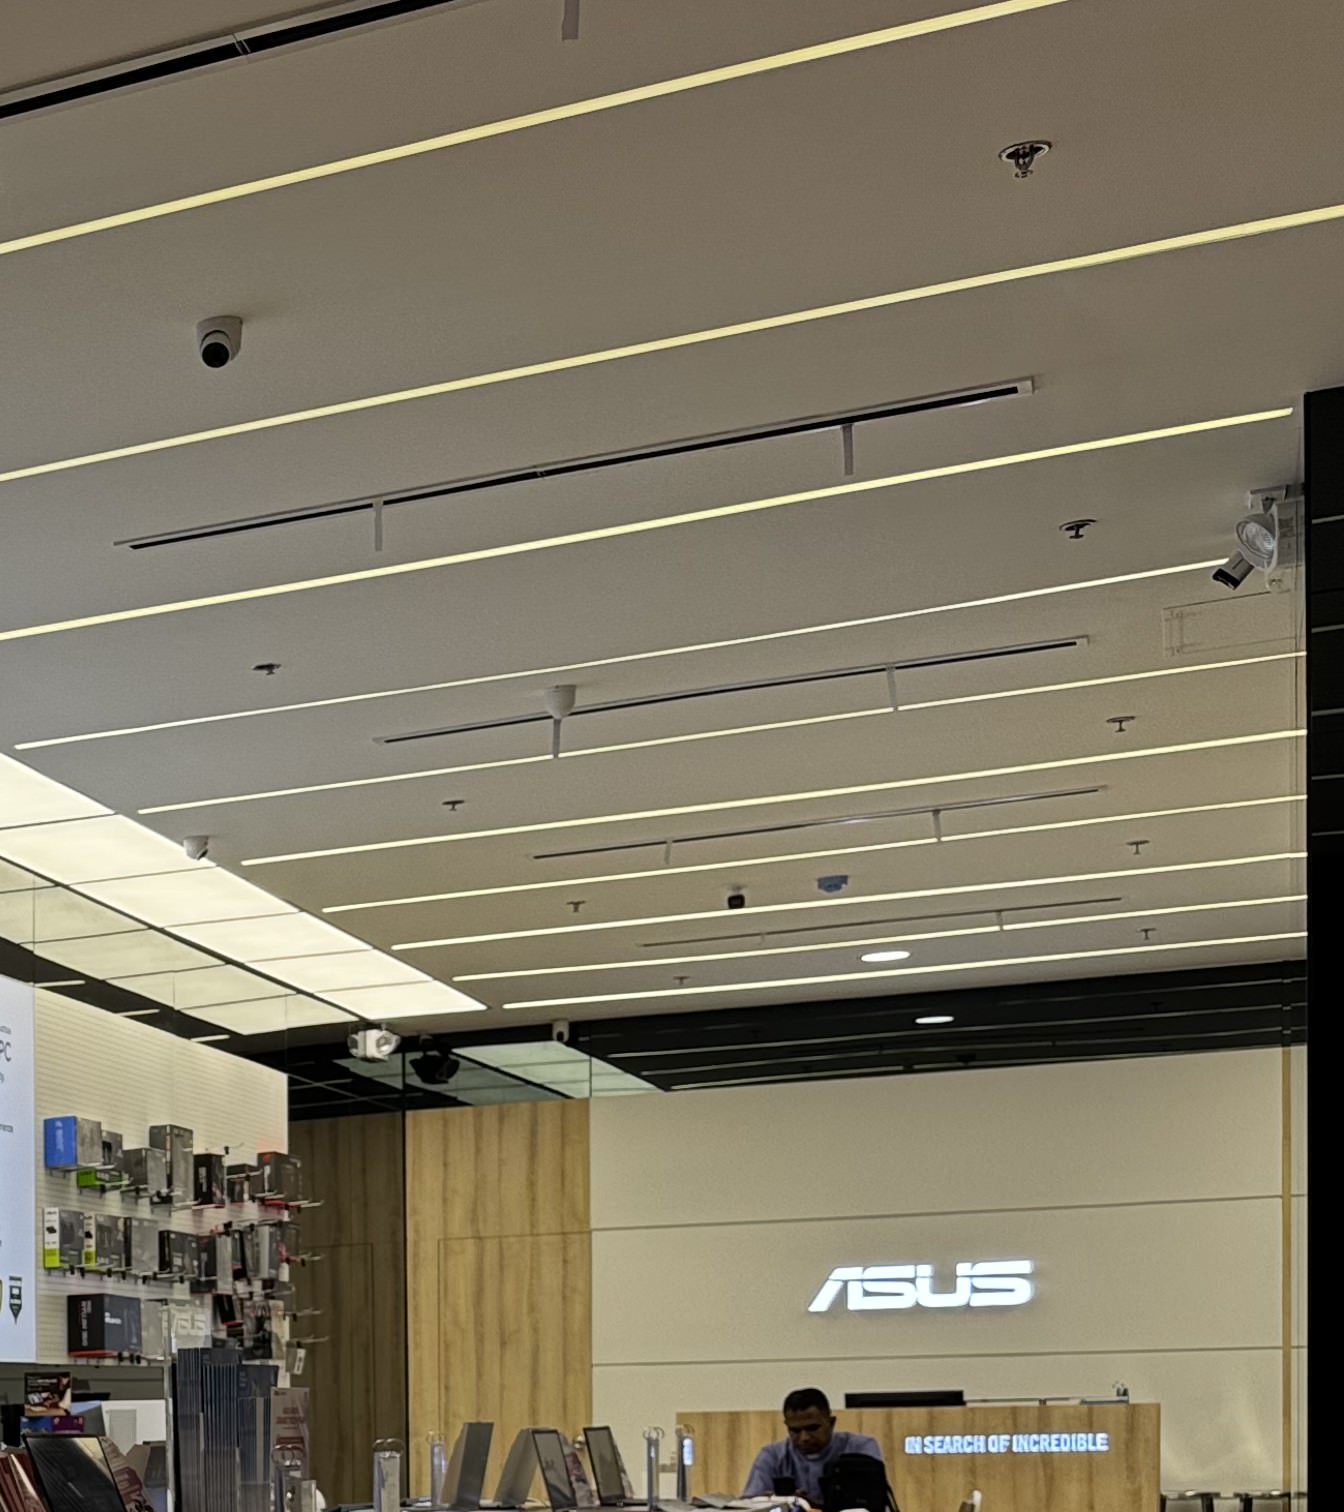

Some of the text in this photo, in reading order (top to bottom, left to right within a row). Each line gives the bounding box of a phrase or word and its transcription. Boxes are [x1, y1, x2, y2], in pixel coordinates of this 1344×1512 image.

[807, 1259, 1034, 1312] ASUS
[905, 1433, 1109, 1454] IN SEARCH OF INCREDIBLE
